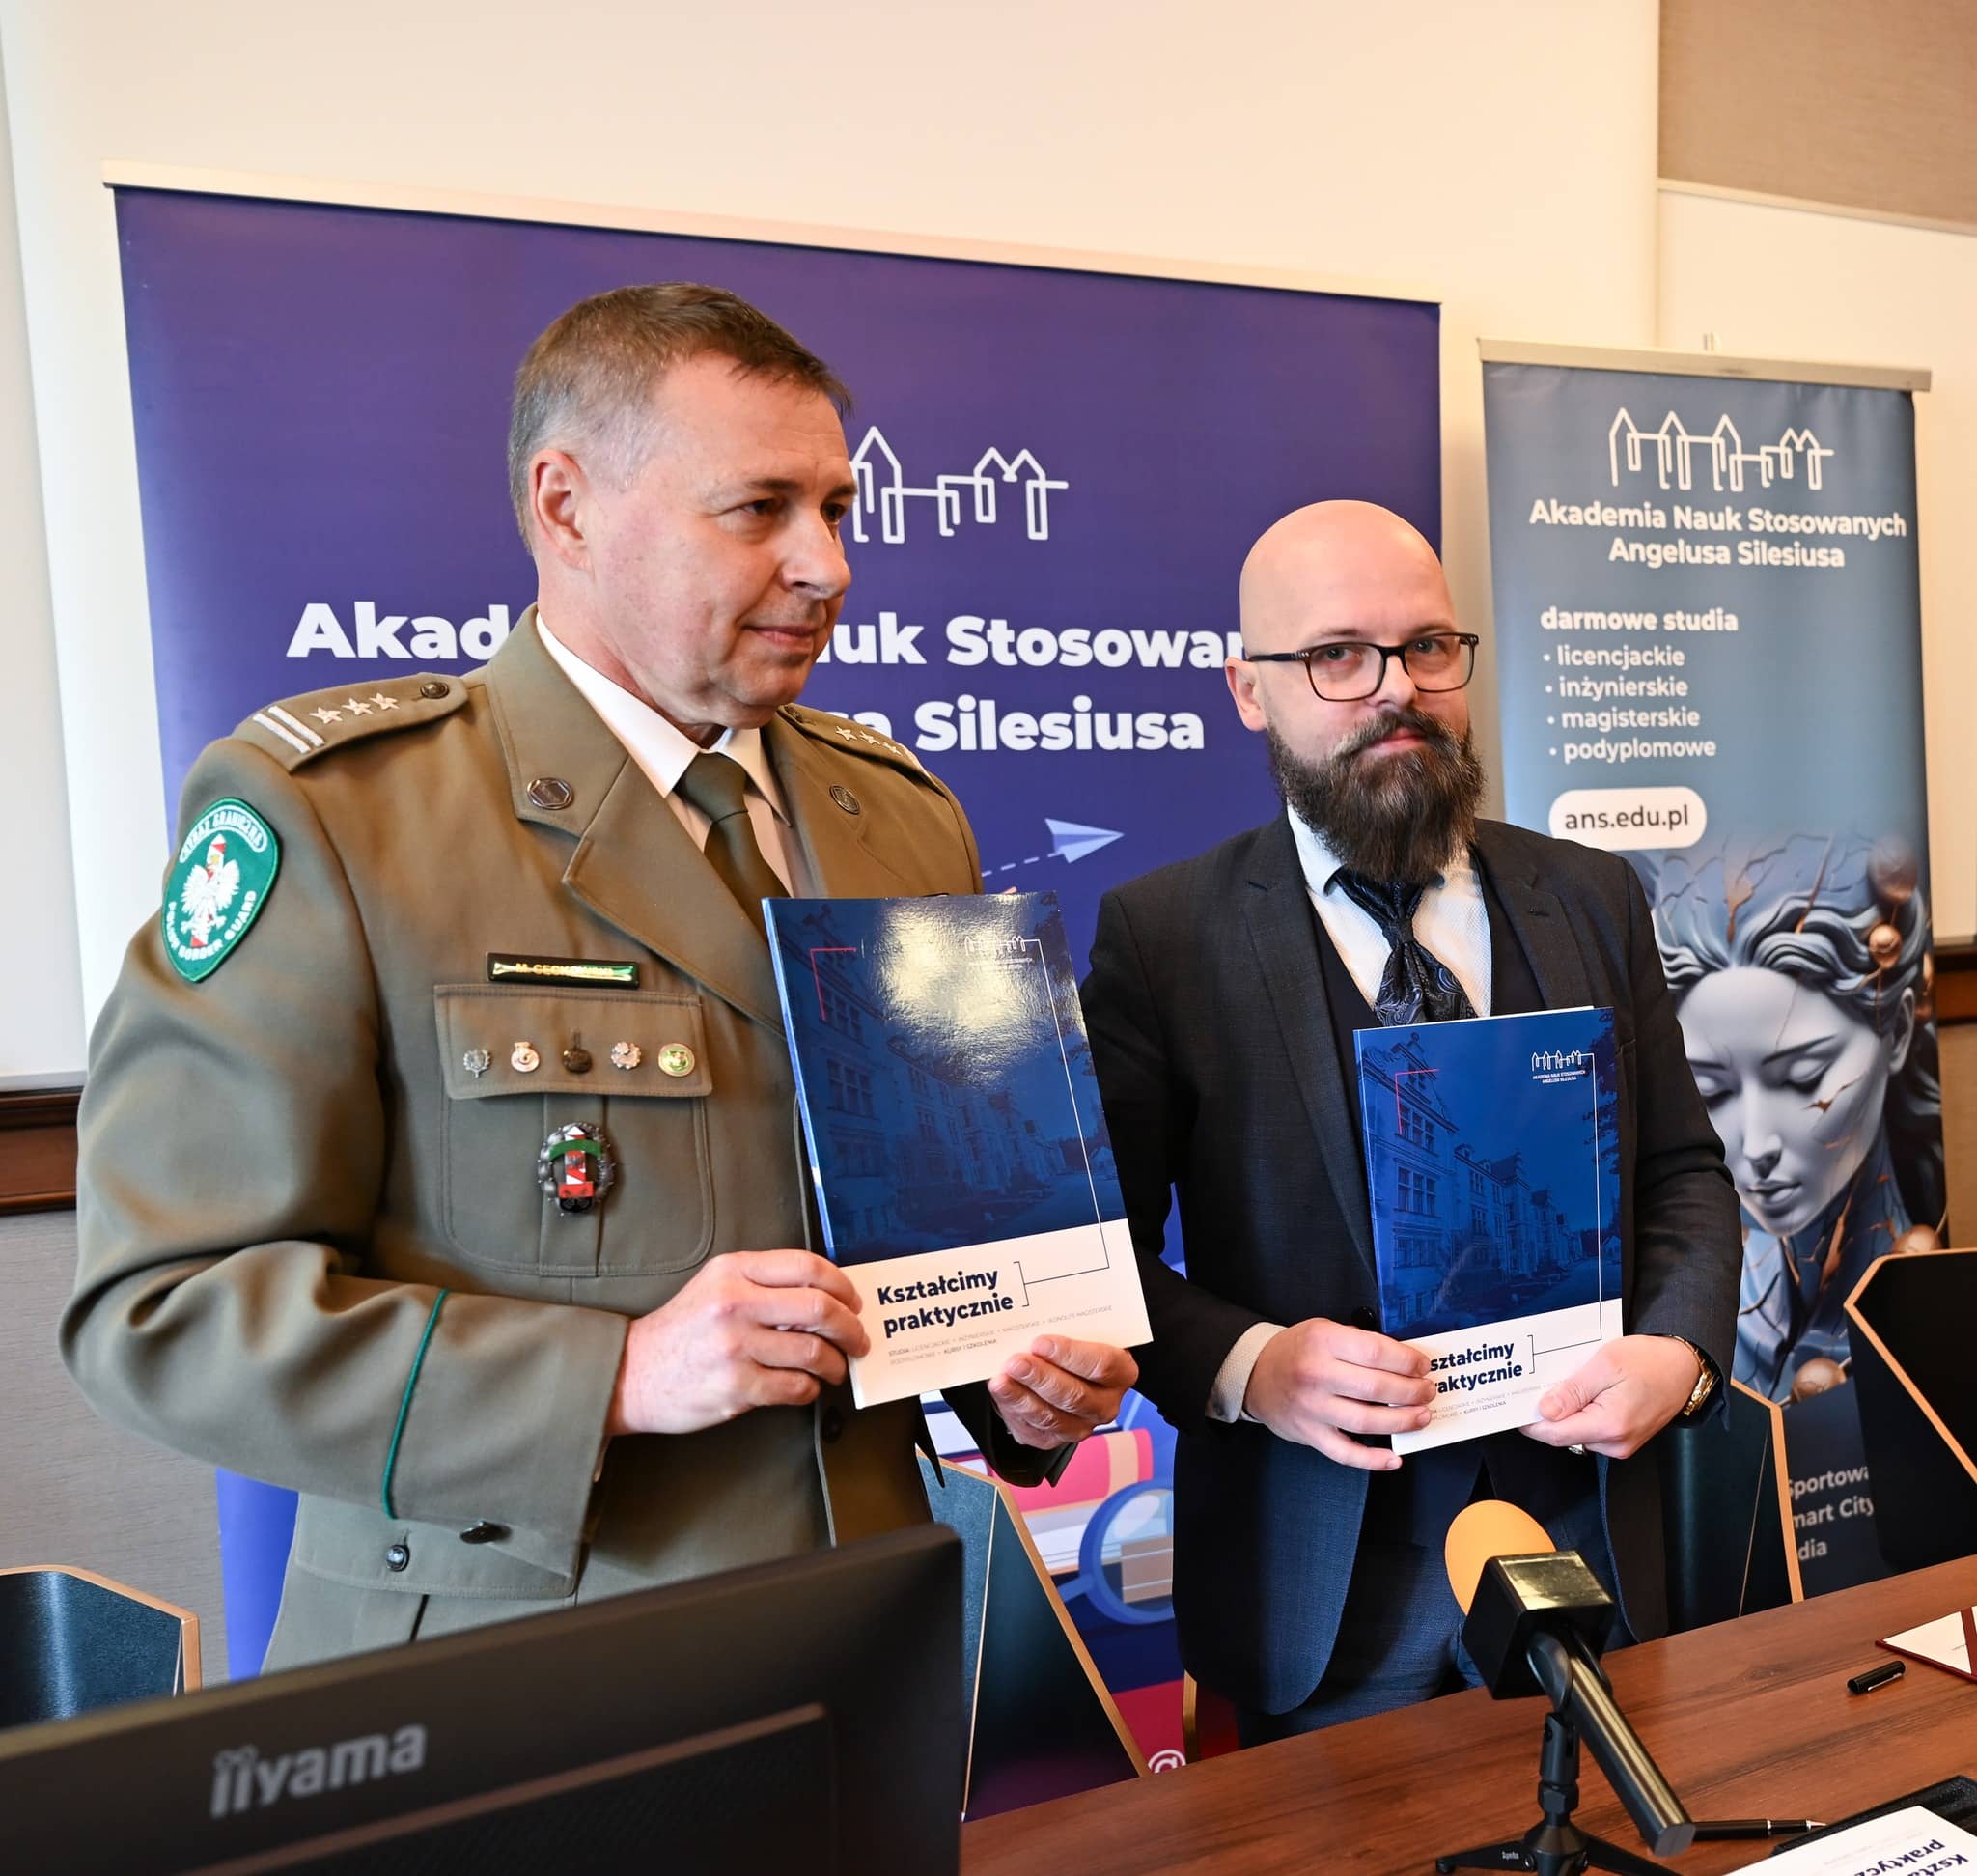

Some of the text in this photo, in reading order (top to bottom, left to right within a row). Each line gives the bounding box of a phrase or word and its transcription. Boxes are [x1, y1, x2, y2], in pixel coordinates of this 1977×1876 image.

[1529, 499, 1907, 538] Akademia Nauk Stosowanych
[1608, 538, 1846, 569] Angelusa Silesiusa
[1541, 606, 1739, 631] darmowe studia
[815, 611, 928, 664] uk
[1557, 645, 1685, 671] licencjackie
[1559, 676, 1689, 701] inżynierskie
[914, 694, 1205, 751] Silesiusa
[1562, 707, 1700, 733] magisterskie
[1564, 738, 1716, 764] podyplomowe
[1565, 803, 1689, 831] ans.edu.pl
[877, 1270, 998, 1305] Kształcimy
[883, 1292, 1014, 1339] praktycznie
[1430, 1343, 1515, 1372] ształcimy
[1434, 1361, 1523, 1394] aktycznie
[209, 1722, 427, 1819] iiyama
